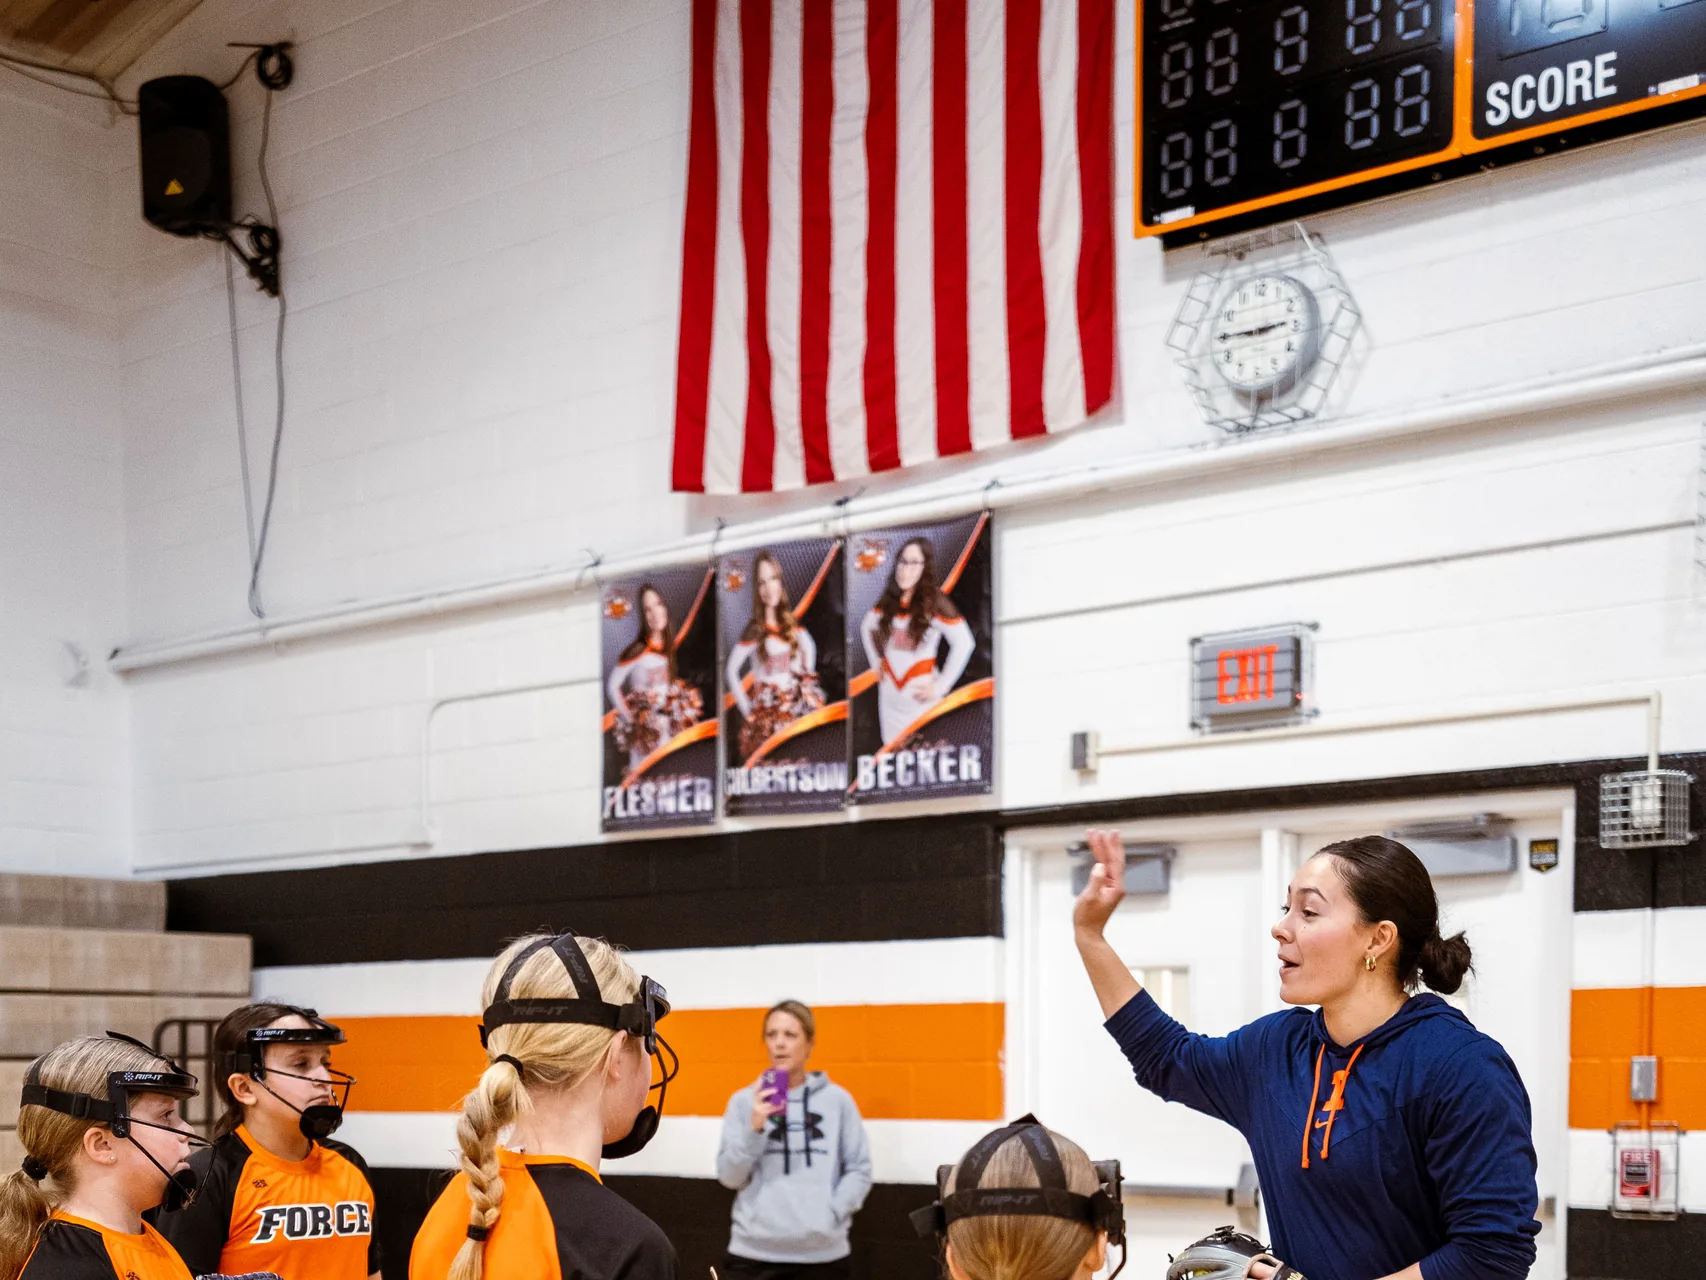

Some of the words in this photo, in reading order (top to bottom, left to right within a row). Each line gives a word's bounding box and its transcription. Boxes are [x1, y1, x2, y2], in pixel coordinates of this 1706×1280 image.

[1485, 51, 1618, 127] SCORE
[1217, 645, 1279, 704] EXIT
[857, 745, 981, 791] BECKER
[134, 1073, 163, 1081] RIP-IT
[1623, 1152, 1652, 1164] FIRE
[249, 1201, 372, 1244] FORCE
